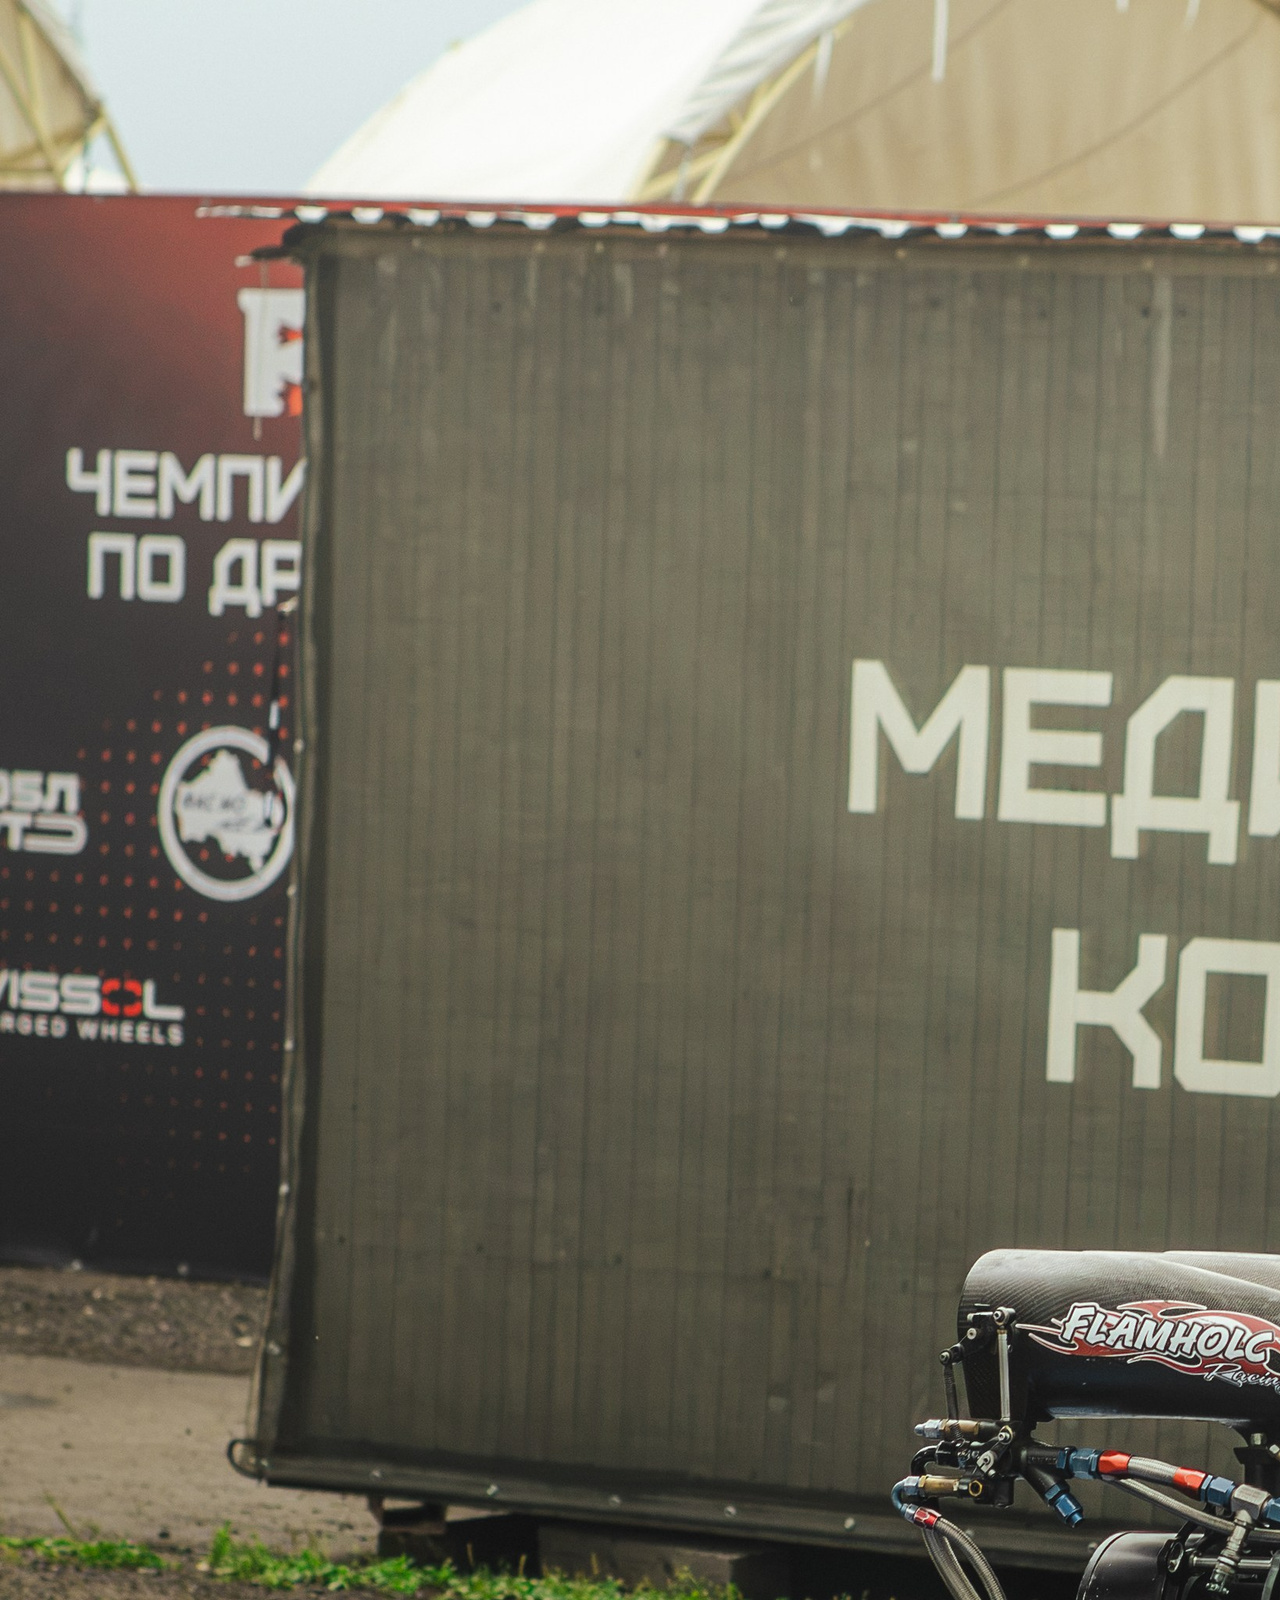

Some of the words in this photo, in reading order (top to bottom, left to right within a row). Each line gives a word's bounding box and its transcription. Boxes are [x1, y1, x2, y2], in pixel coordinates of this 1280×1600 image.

[87, 531, 186, 603] ПО
[77, 1018, 184, 1047] WHEELS
[1061, 1305, 1275, 1364] FLAMHOLC
